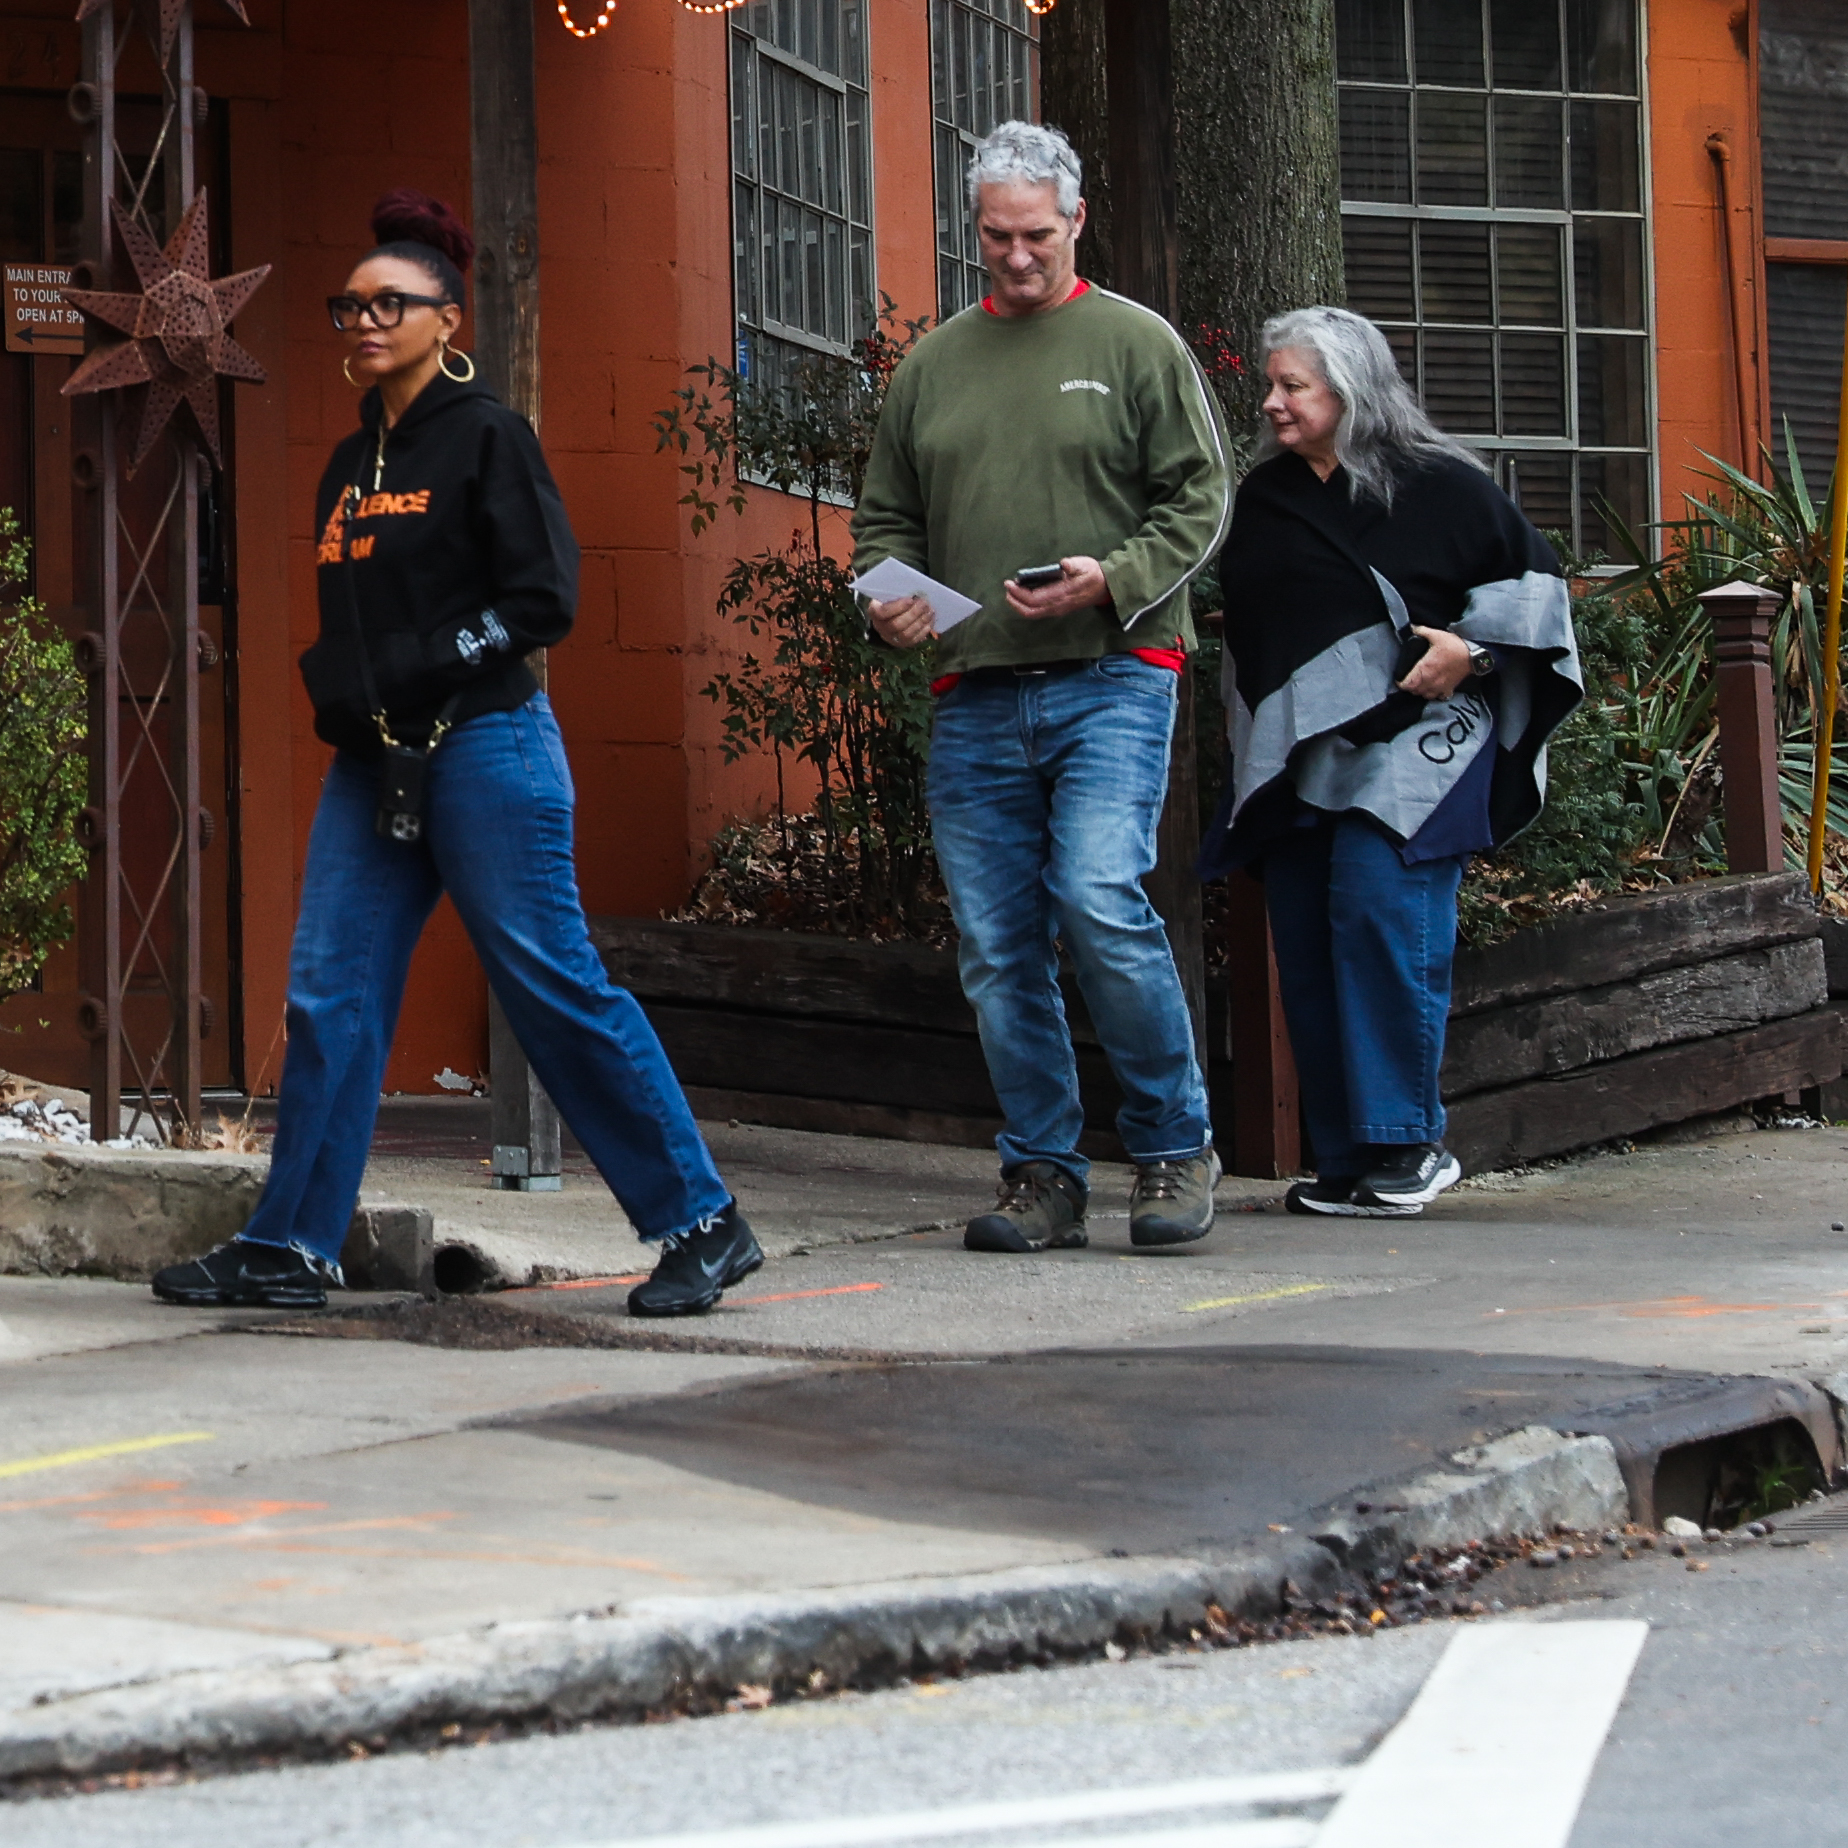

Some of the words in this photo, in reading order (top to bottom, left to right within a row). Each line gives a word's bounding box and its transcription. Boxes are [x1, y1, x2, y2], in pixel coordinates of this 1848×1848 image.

[6, 268, 34, 282] MAIN
[13, 288, 28, 302] TO
[31, 289, 61, 303] YOUR
[16, 308, 47, 322] OPEN
[49, 310, 64, 323] AT
